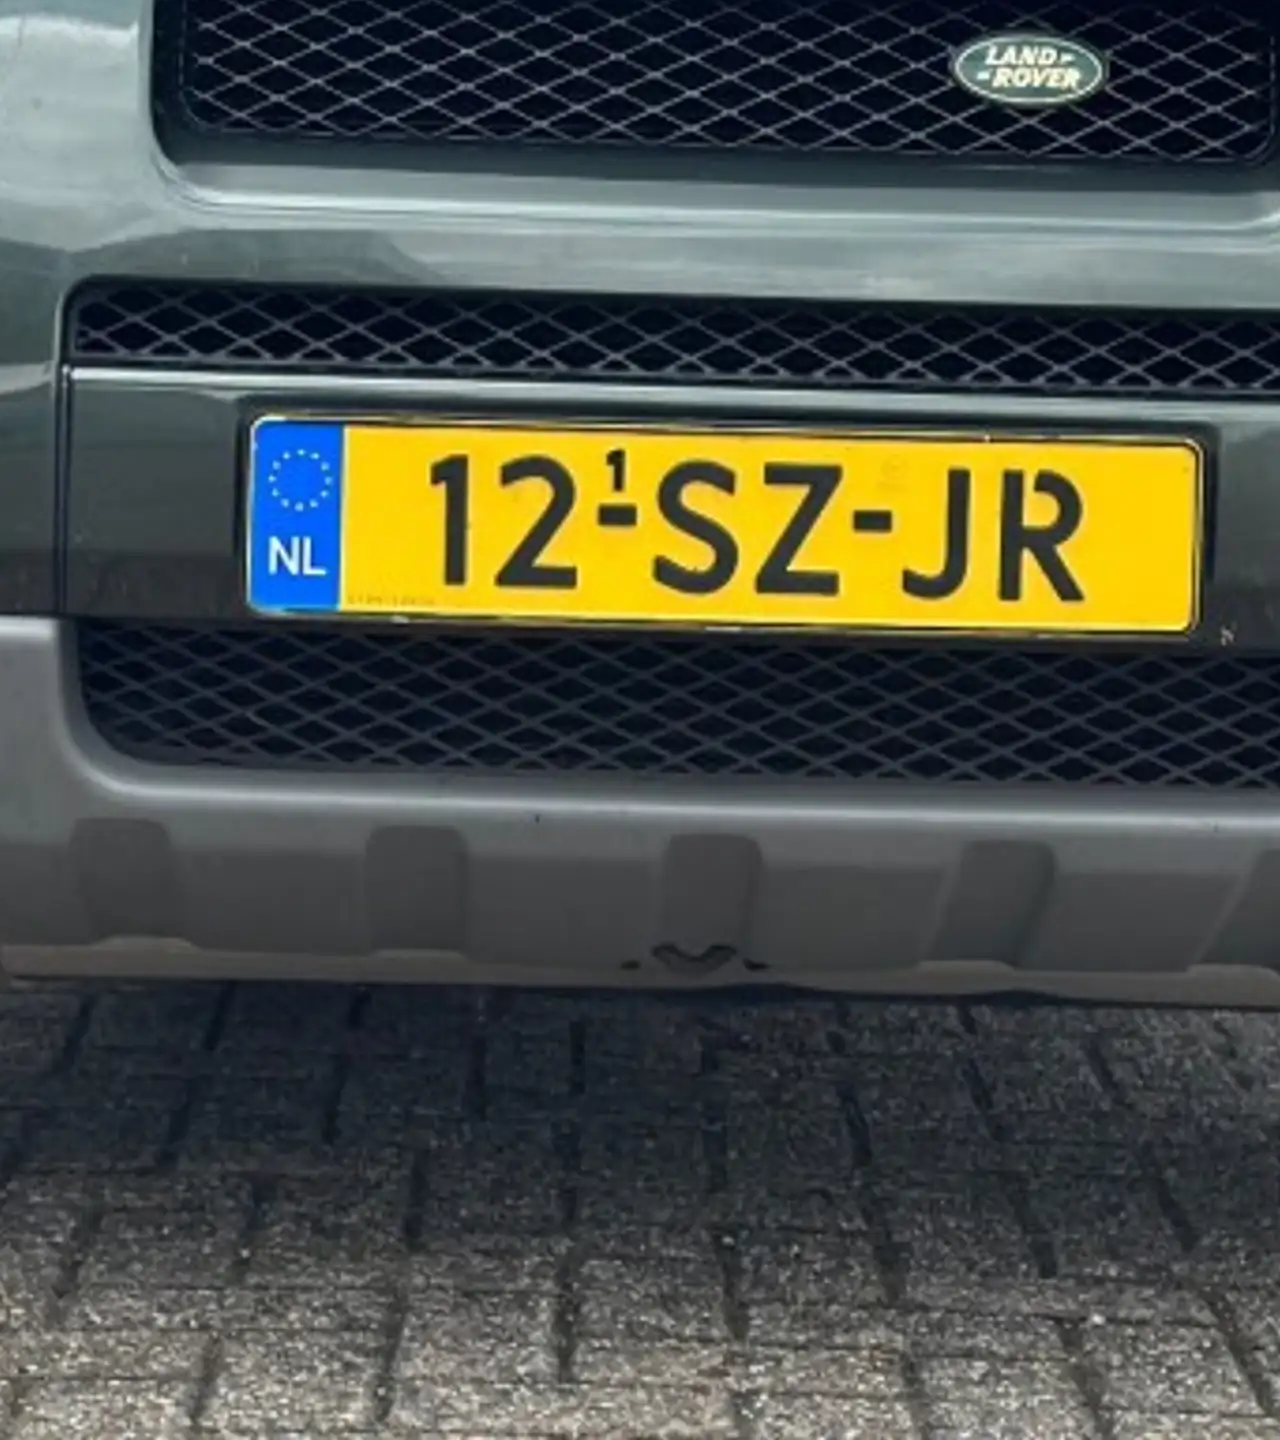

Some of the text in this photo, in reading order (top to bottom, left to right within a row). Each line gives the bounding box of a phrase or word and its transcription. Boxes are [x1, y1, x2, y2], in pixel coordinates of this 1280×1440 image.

[985, 44, 1058, 66] LAND
[992, 66, 1081, 89] ROVER
[268, 536, 326, 576] NL
